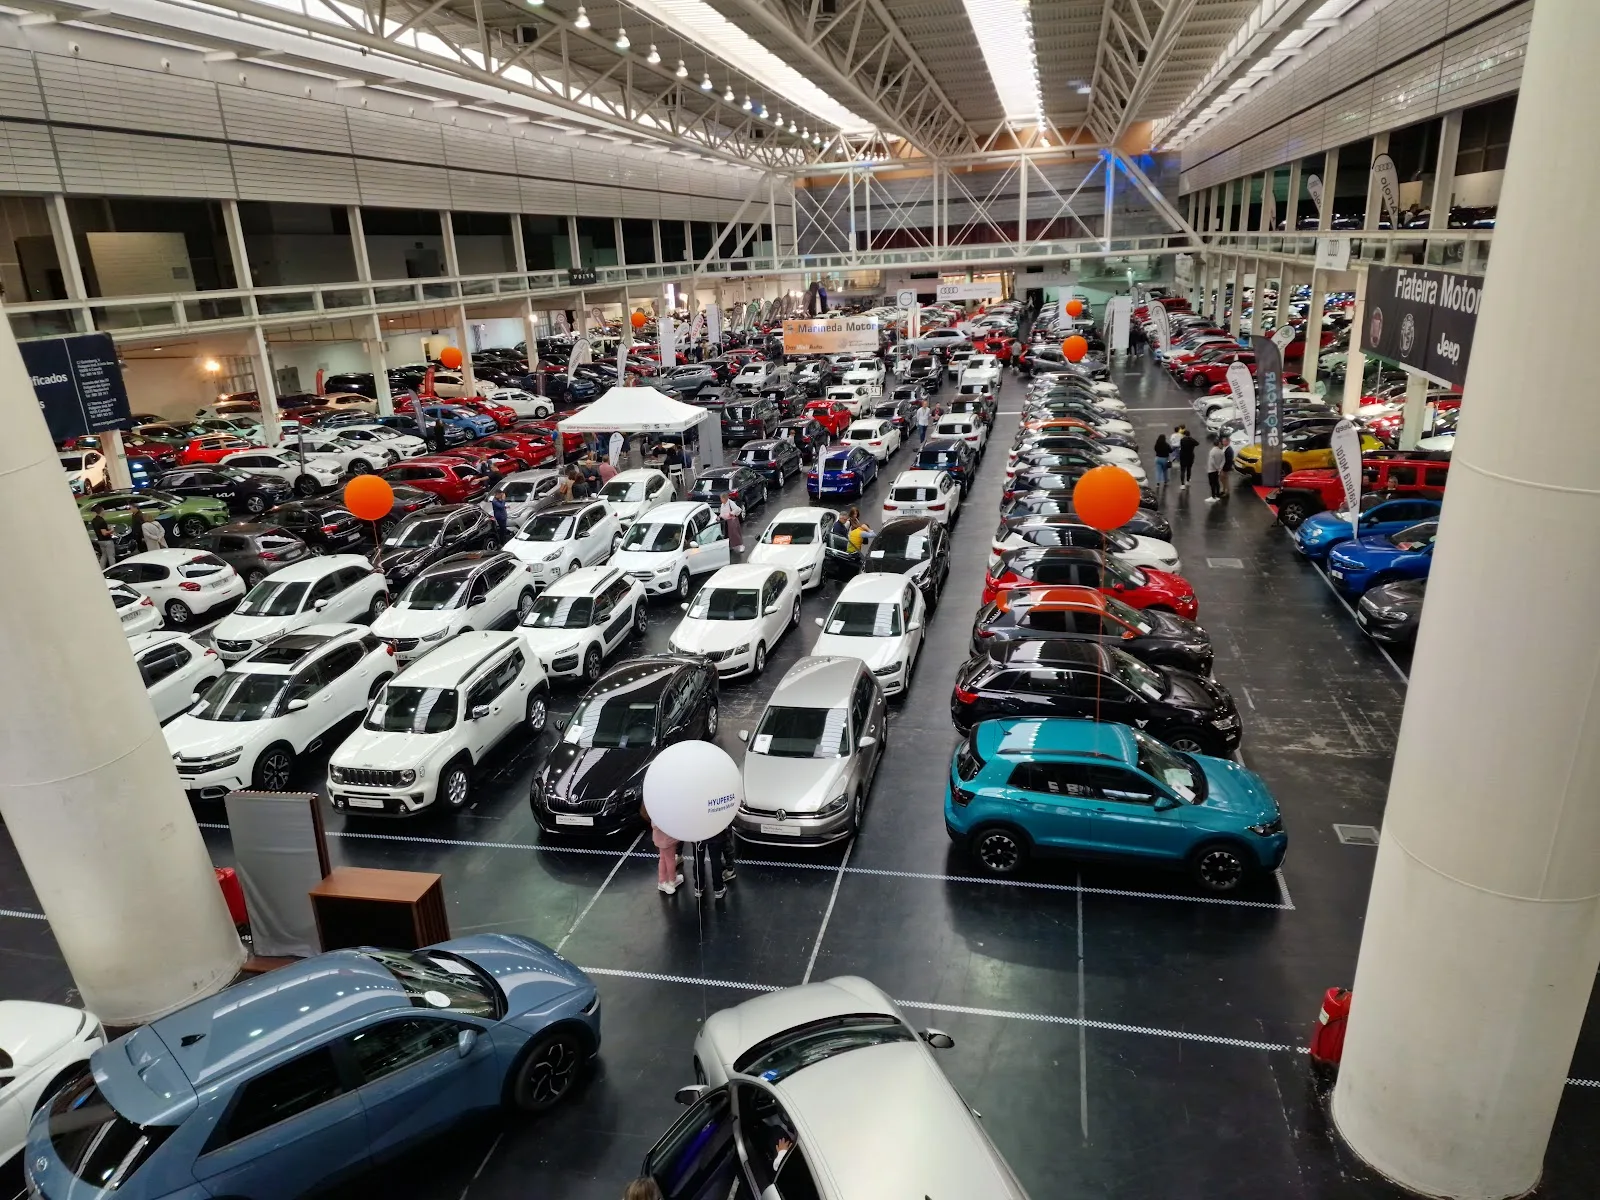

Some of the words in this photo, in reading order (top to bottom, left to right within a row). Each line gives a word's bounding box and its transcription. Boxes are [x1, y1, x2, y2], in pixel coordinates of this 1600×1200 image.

[1395, 269, 1438, 305] Fiateira
[1439, 274, 1483, 315] Motor
[798, 323, 842, 333] Marineda
[846, 322, 877, 332] Motor
[1437, 332, 1460, 364] Jeep
[30, 373, 68, 386] ficados
